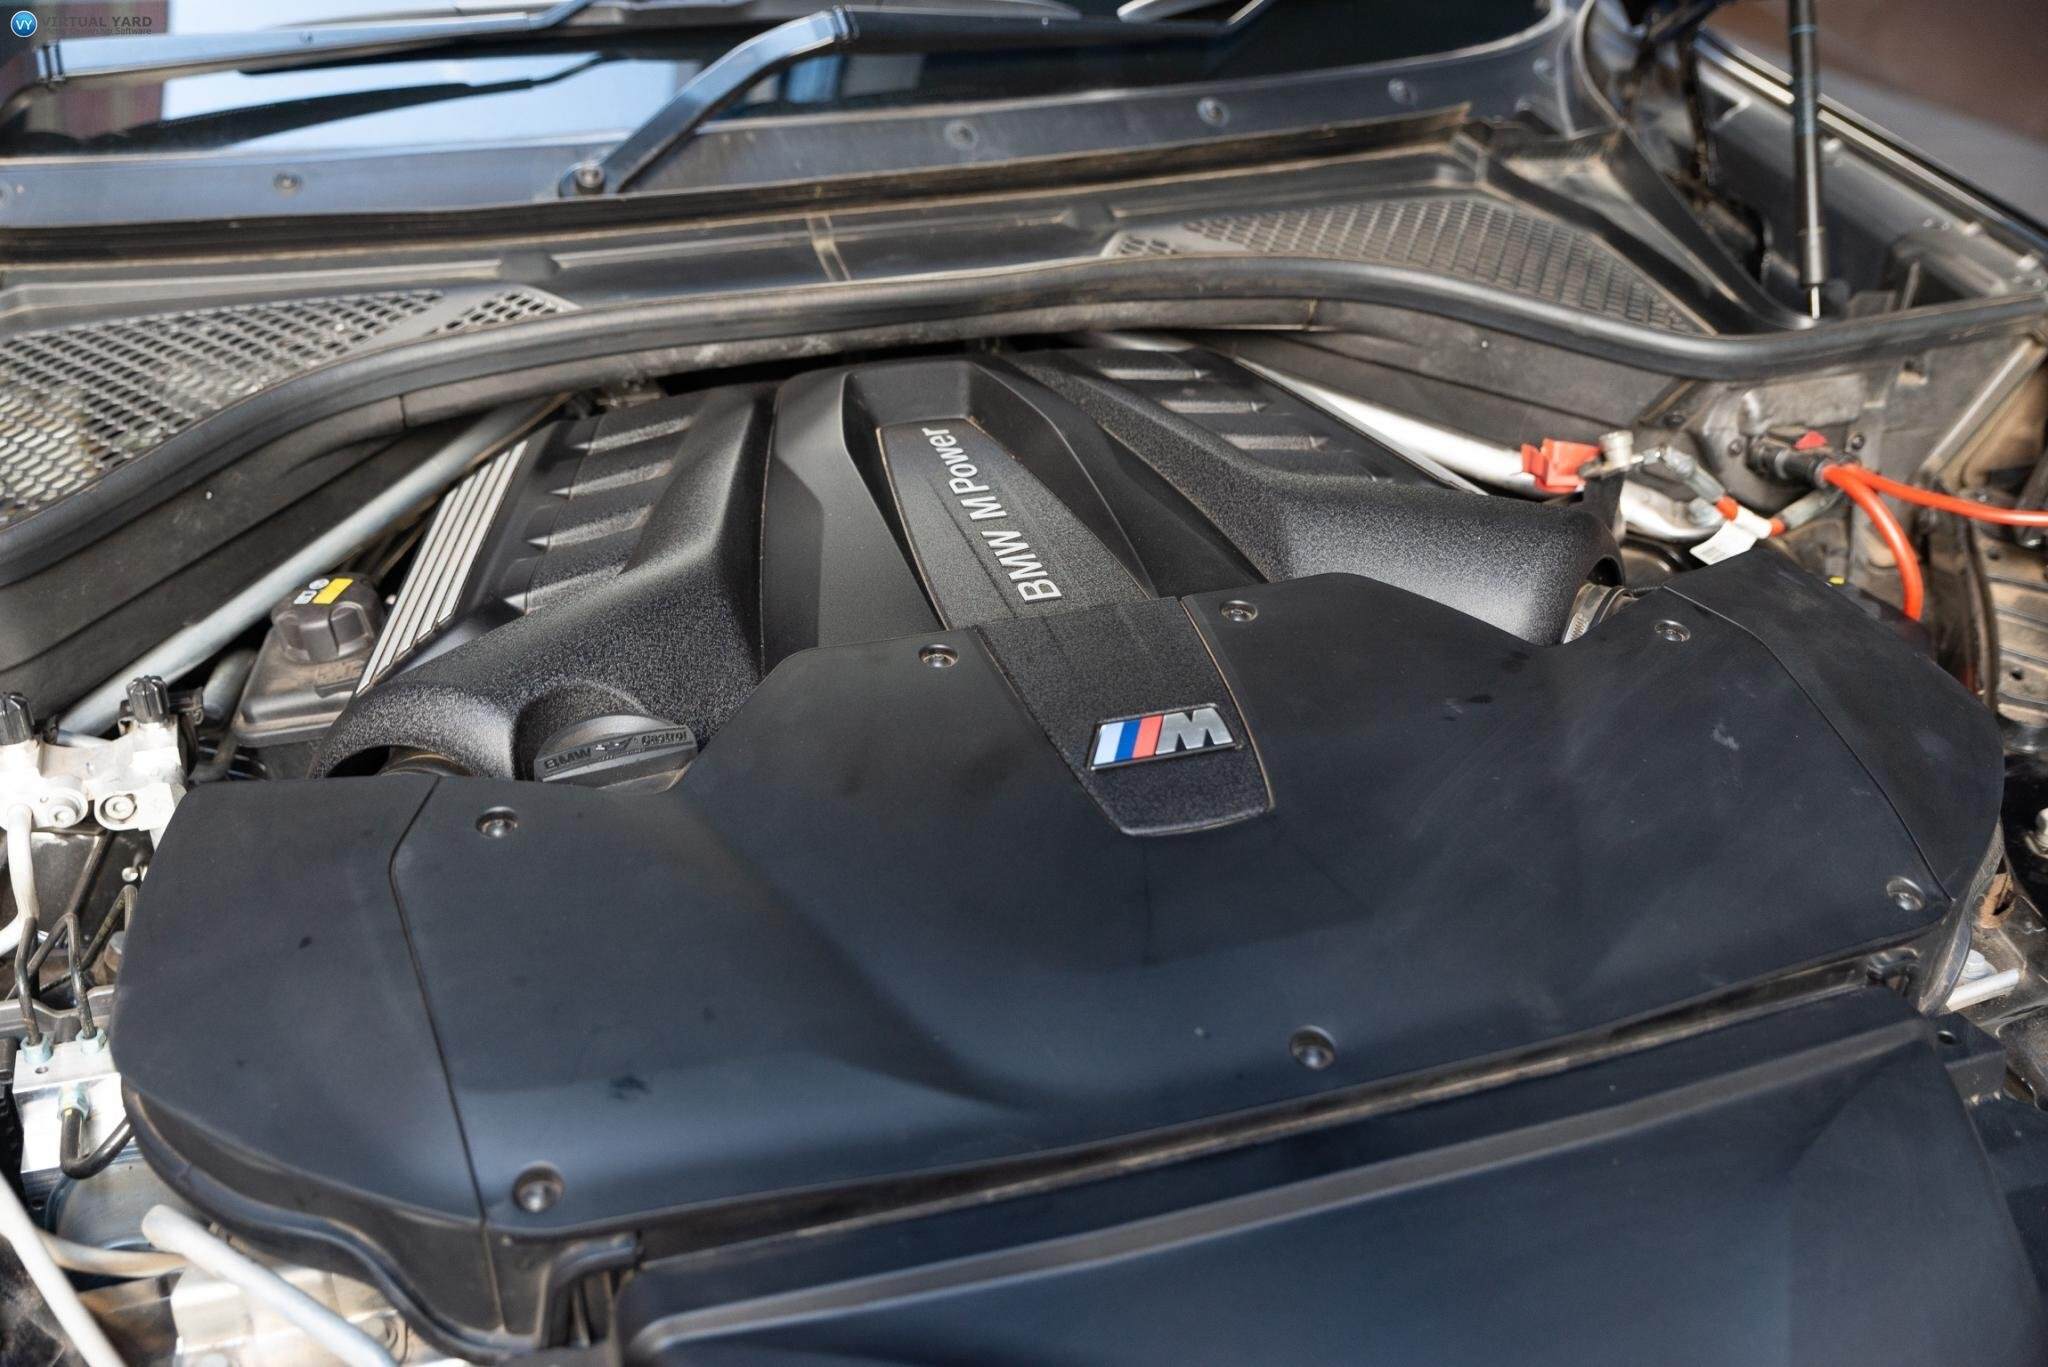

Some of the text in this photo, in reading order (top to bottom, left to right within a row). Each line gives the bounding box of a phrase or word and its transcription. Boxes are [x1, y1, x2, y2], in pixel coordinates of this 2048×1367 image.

[981, 530, 1063, 602] BMW
[1155, 707, 1234, 756] M
[543, 747, 592, 770] BMW
